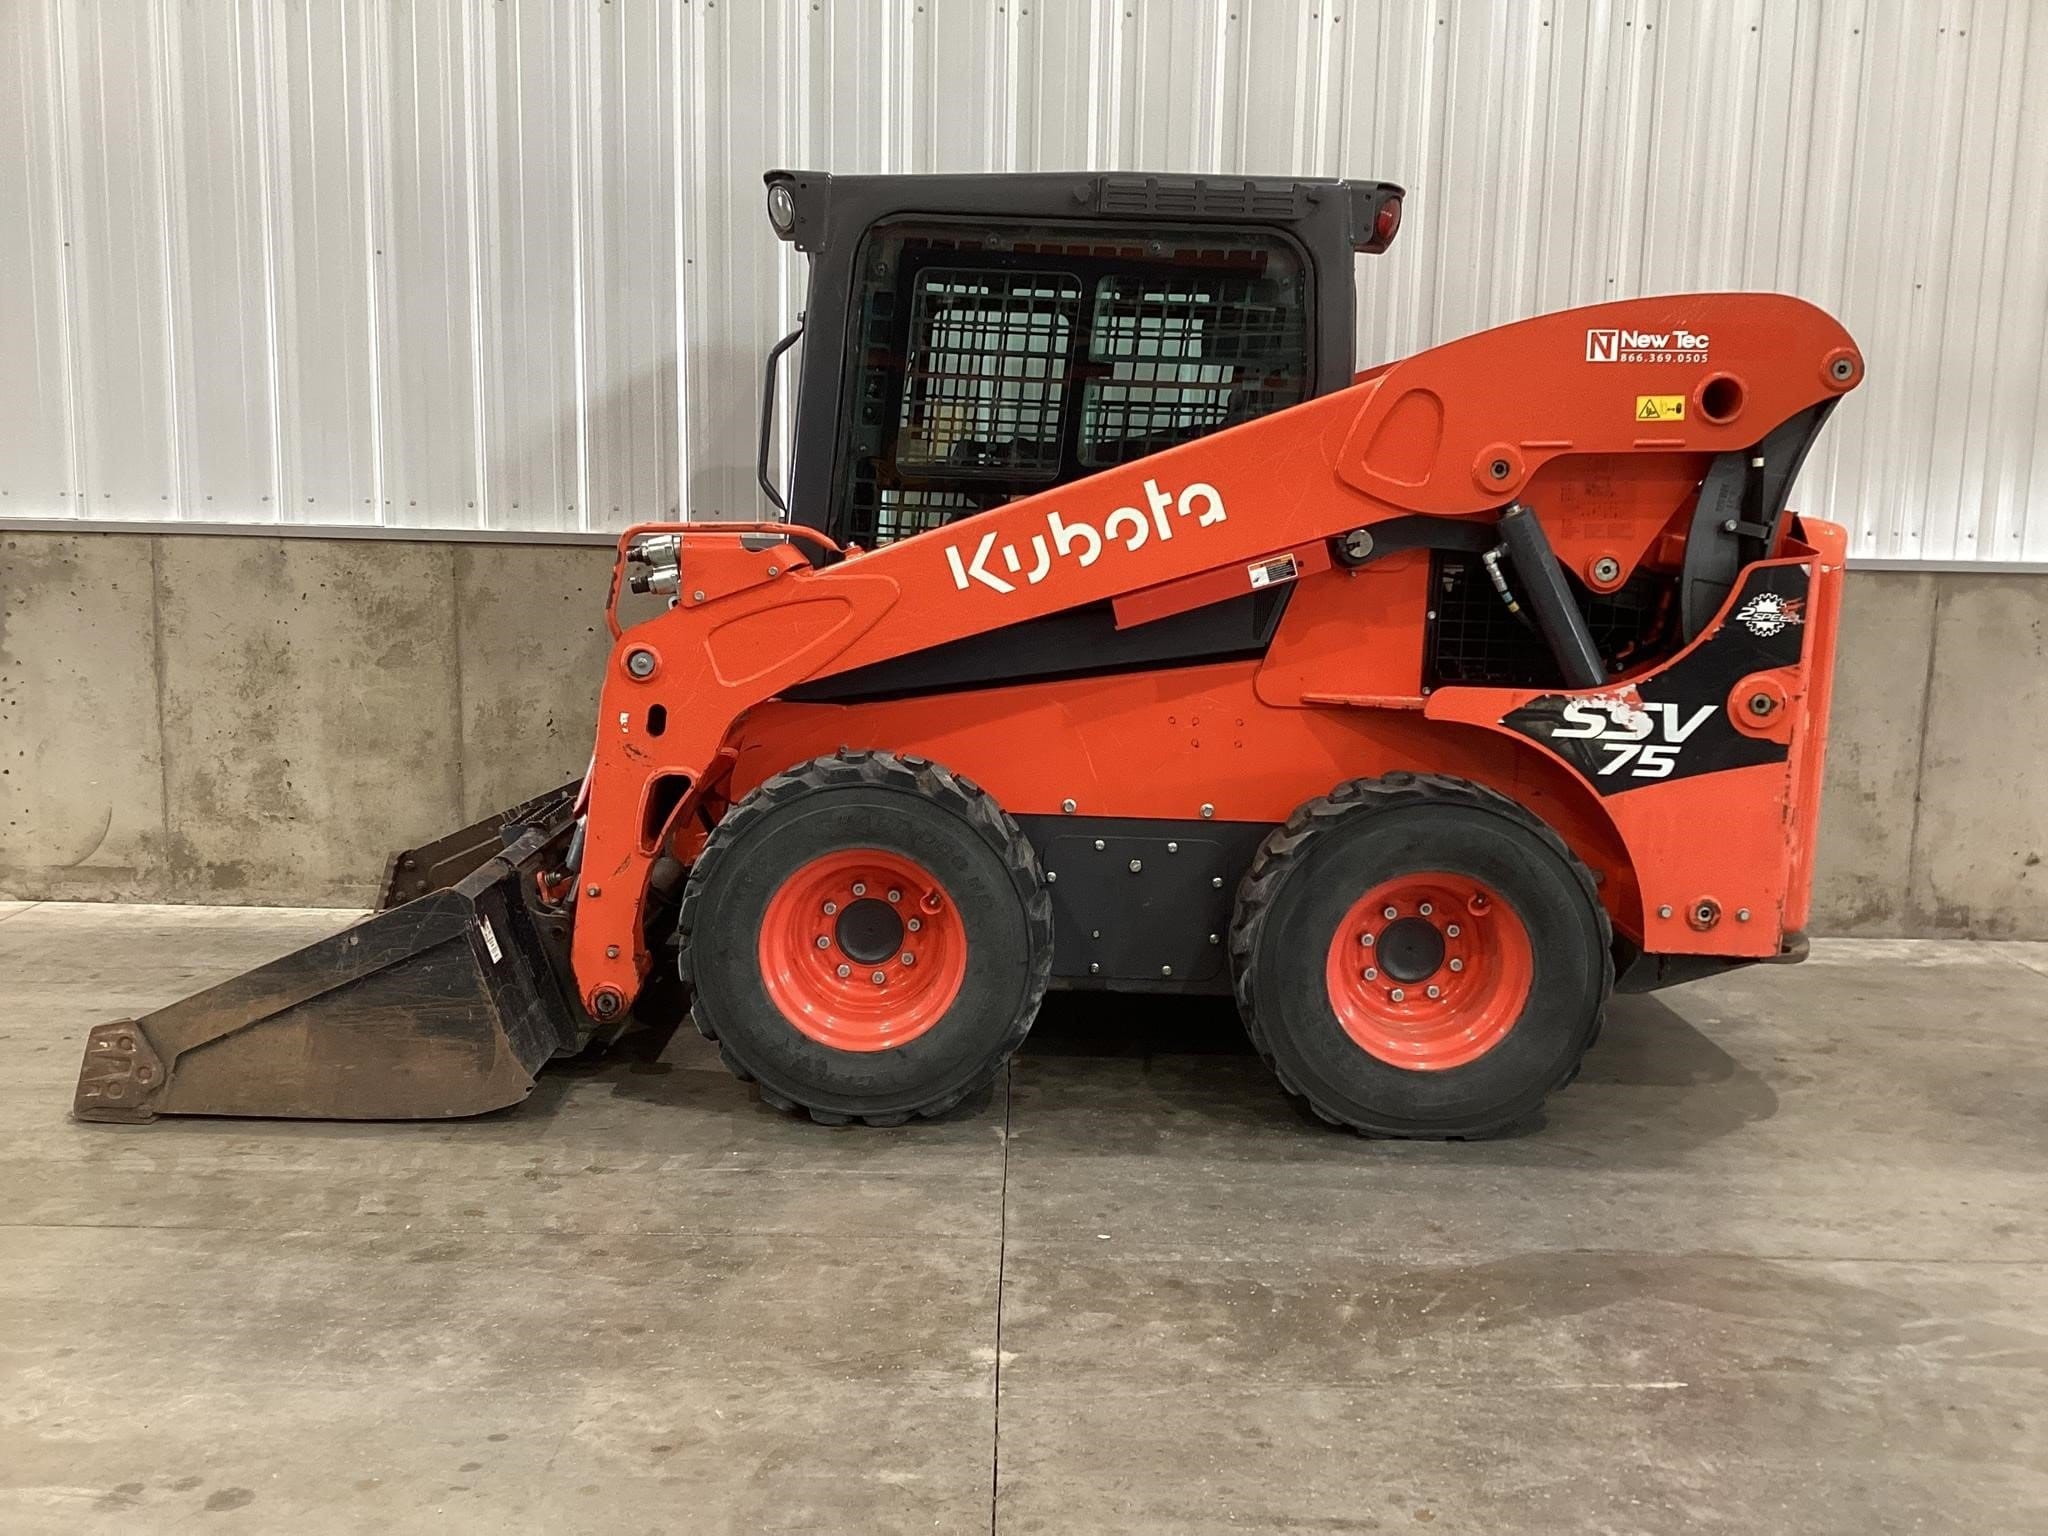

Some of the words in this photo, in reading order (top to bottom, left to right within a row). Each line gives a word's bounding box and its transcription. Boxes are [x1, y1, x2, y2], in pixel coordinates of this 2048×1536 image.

[1621, 330, 1670, 349] New
[1672, 330, 1710, 349] Tec
[1620, 353, 1708, 363] 866.369.0505
[945, 478, 1228, 594] Kubota
[1551, 701, 1719, 743] SSV
[1597, 743, 1681, 778] 75
